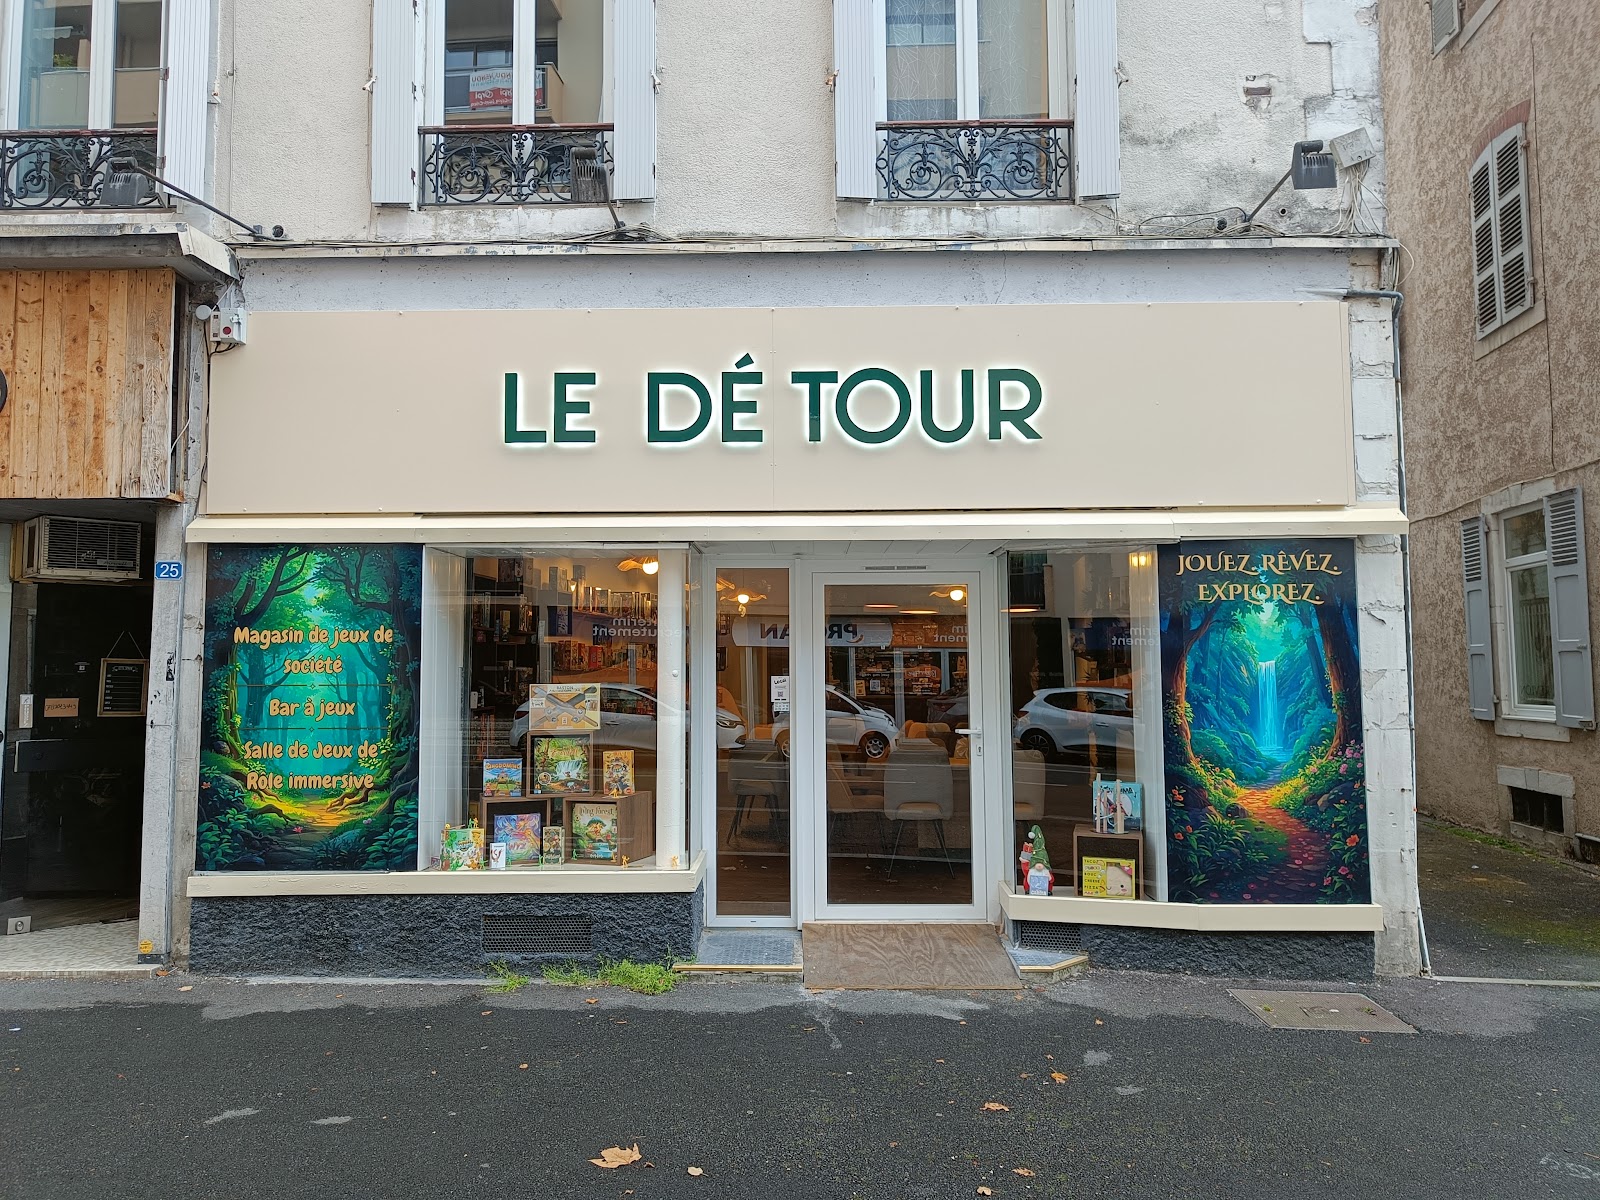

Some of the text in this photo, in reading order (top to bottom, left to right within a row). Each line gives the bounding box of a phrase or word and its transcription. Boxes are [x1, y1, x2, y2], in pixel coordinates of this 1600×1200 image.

[504, 352, 1043, 444] LE DÉ TOUR
[160, 564, 179, 578] 25
[1262, 549, 1342, 576] RÊVEZ.
[1198, 581, 1325, 605] EXPLOREZ.
[233, 626, 394, 650] Magasin de jeux de
[283, 655, 343, 674] société
[269, 699, 356, 722] Bar à jeux
[243, 740, 283, 759] Salle
[288, 740, 310, 759] de
[357, 740, 378, 759] de
[246, 771, 374, 789] Rôle immersive
